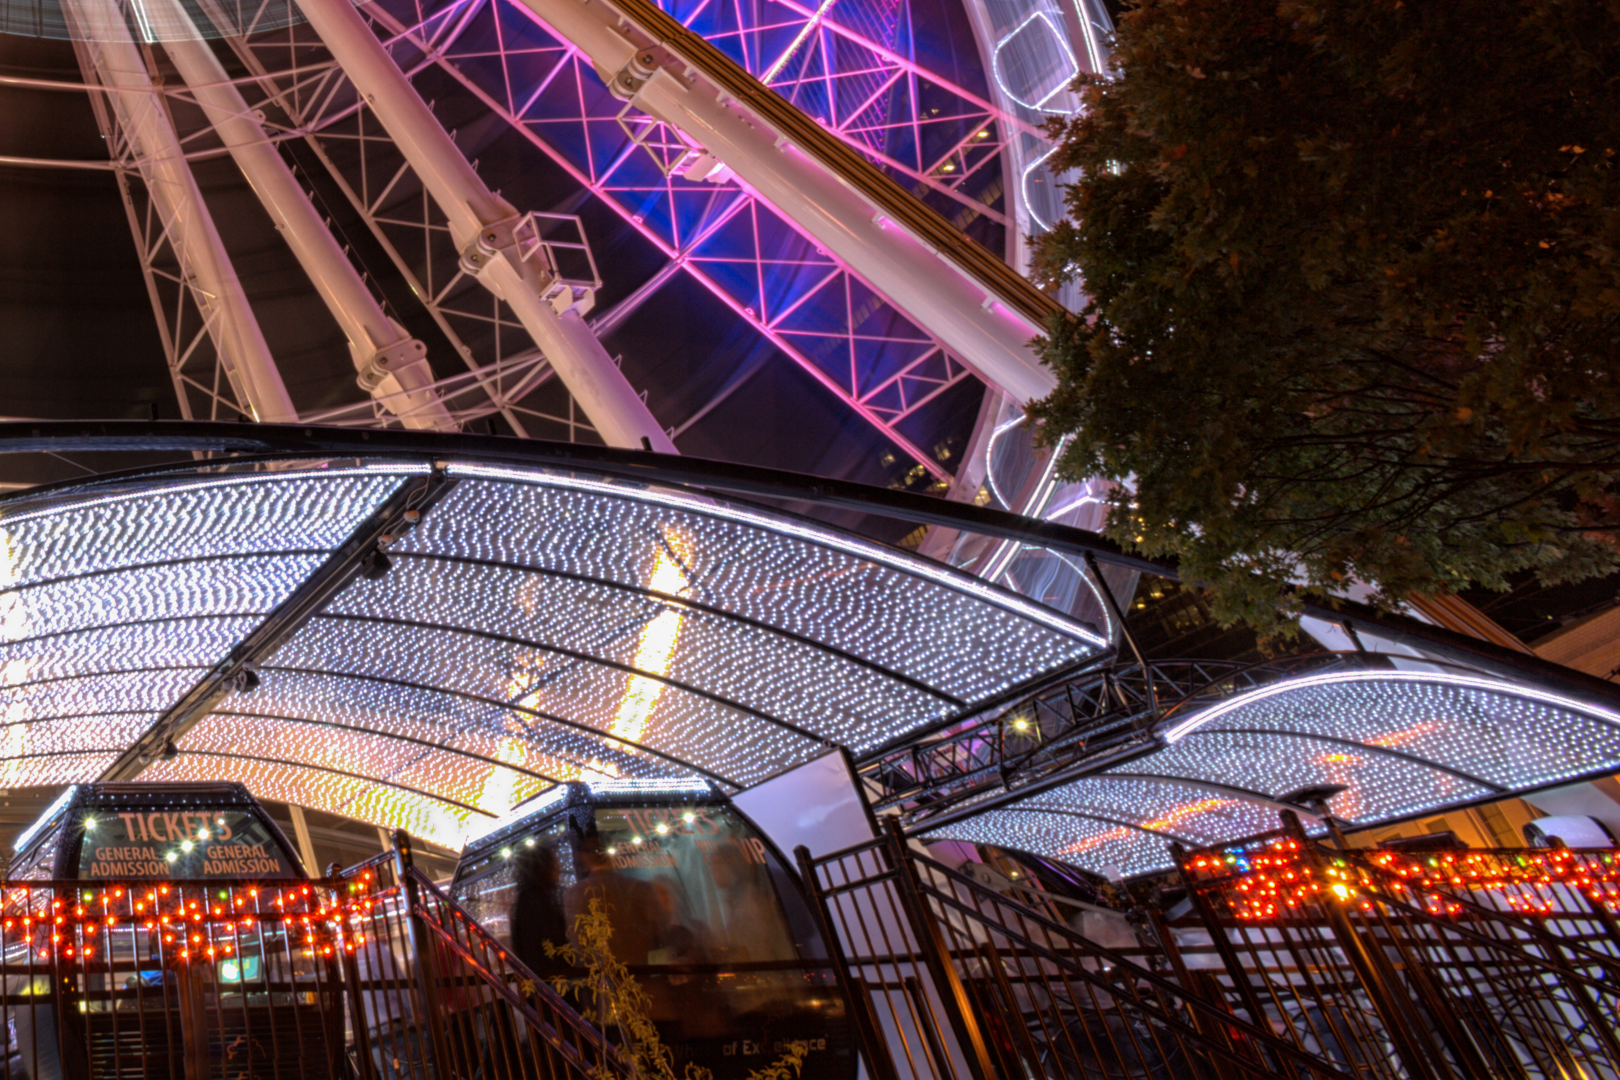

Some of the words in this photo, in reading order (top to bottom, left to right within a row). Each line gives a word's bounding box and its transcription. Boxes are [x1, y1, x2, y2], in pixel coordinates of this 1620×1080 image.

[118, 812, 233, 842] TICKETS
[617, 808, 720, 836] TICKETS
[95, 846, 160, 861] GENERAL
[207, 844, 270, 859] GENERAL
[204, 858, 281, 875] ADMISSION
[611, 853, 678, 868] ADMISSION
[91, 861, 170, 877] ADMISSION
[723, 1041, 739, 1056] of
[743, 1037, 827, 1056] Exellce
